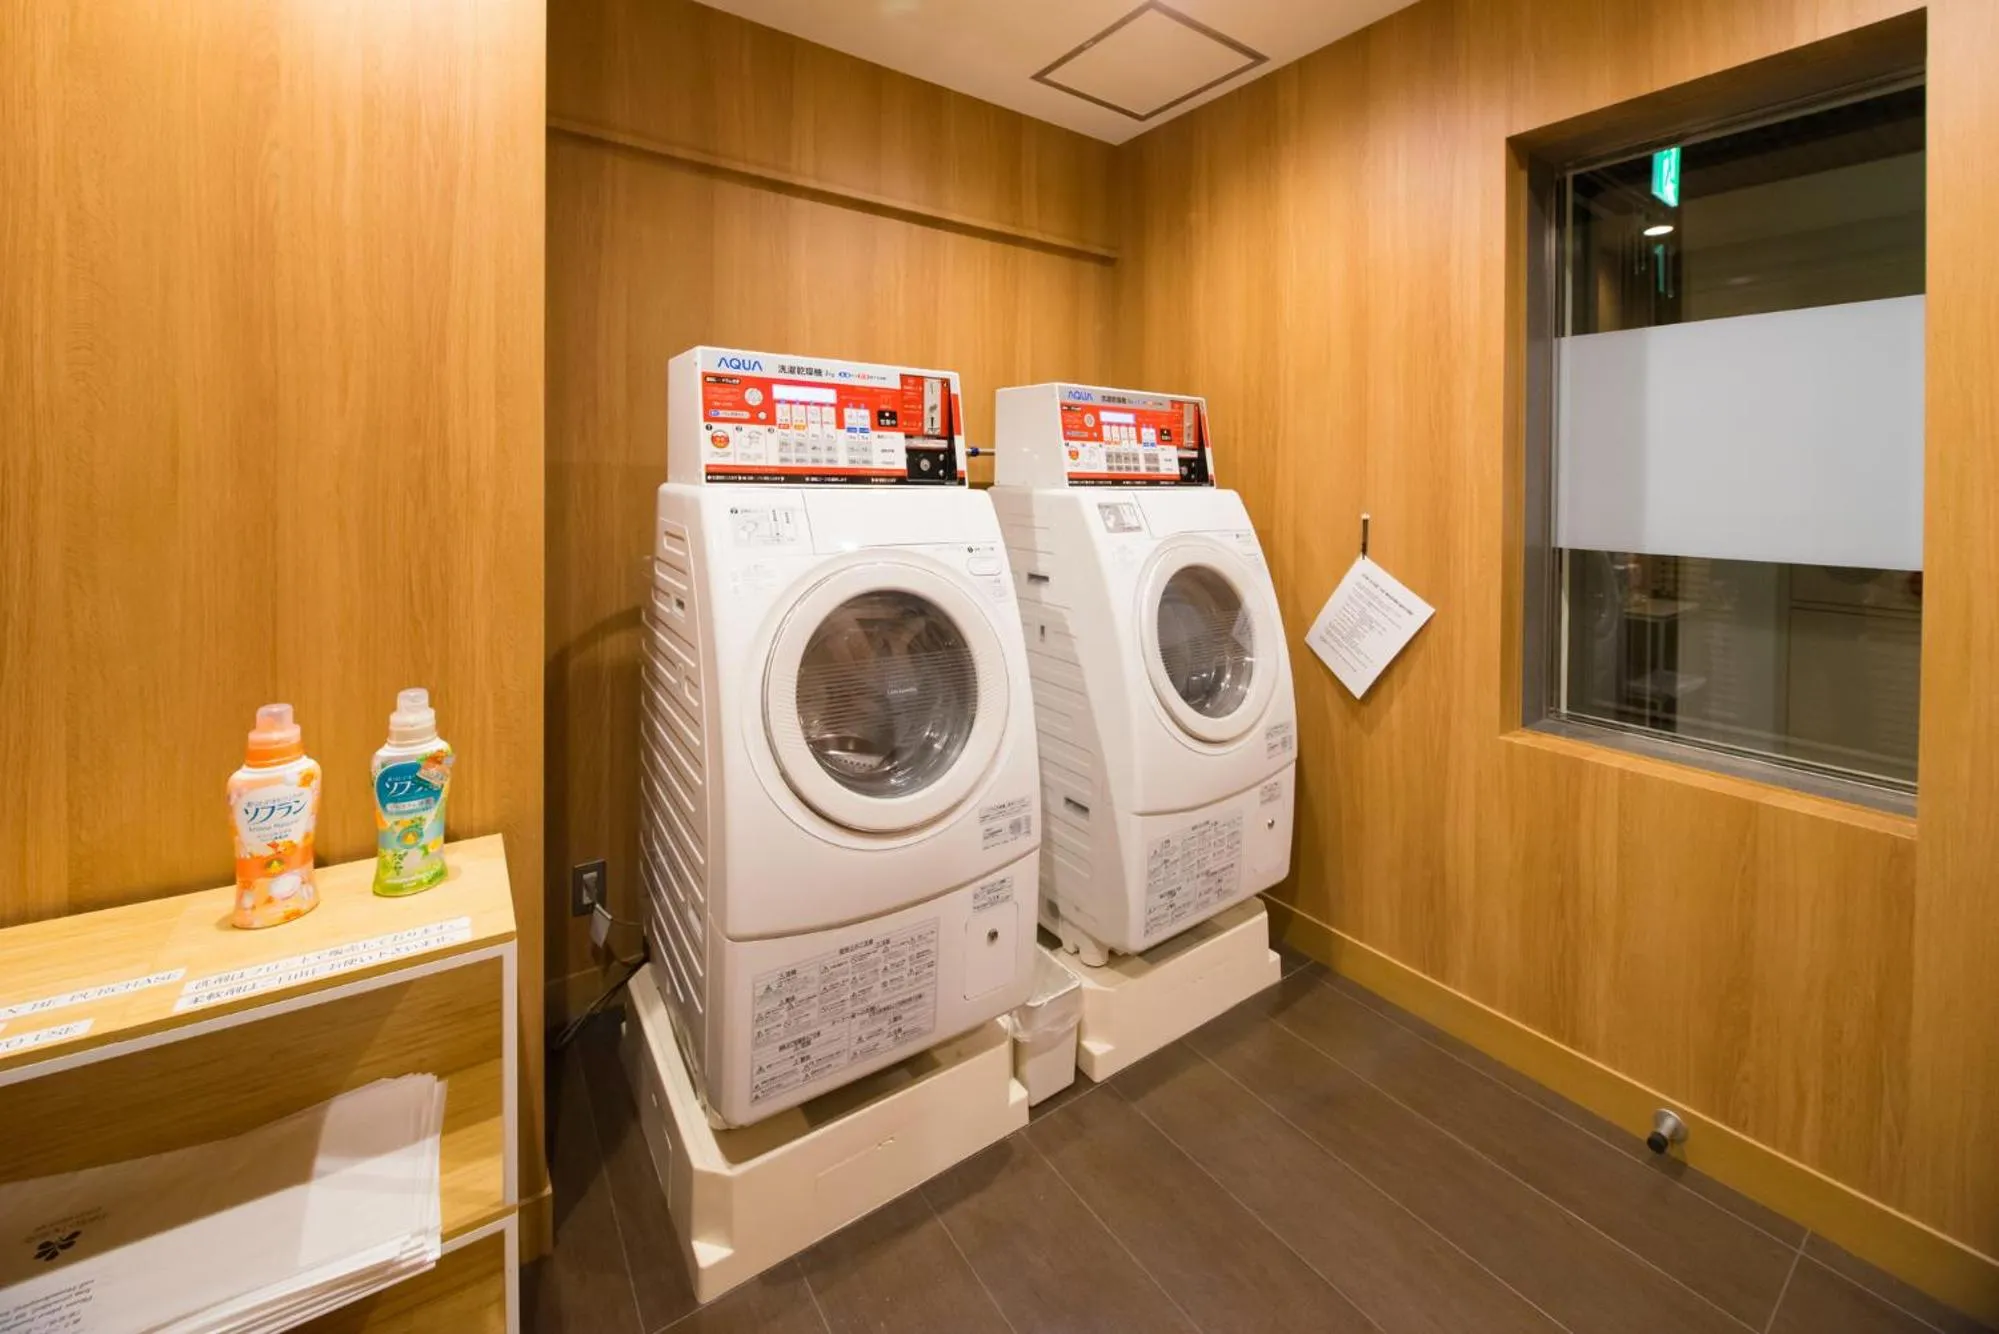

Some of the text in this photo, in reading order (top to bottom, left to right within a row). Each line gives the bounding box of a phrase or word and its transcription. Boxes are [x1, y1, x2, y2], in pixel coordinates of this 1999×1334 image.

[717, 356, 763, 372] AQUA
[777, 364, 823, 377] 洗濯乾燥機
[1068, 389, 1094, 401] AQUA
[243, 799, 308, 824] ソフラン
